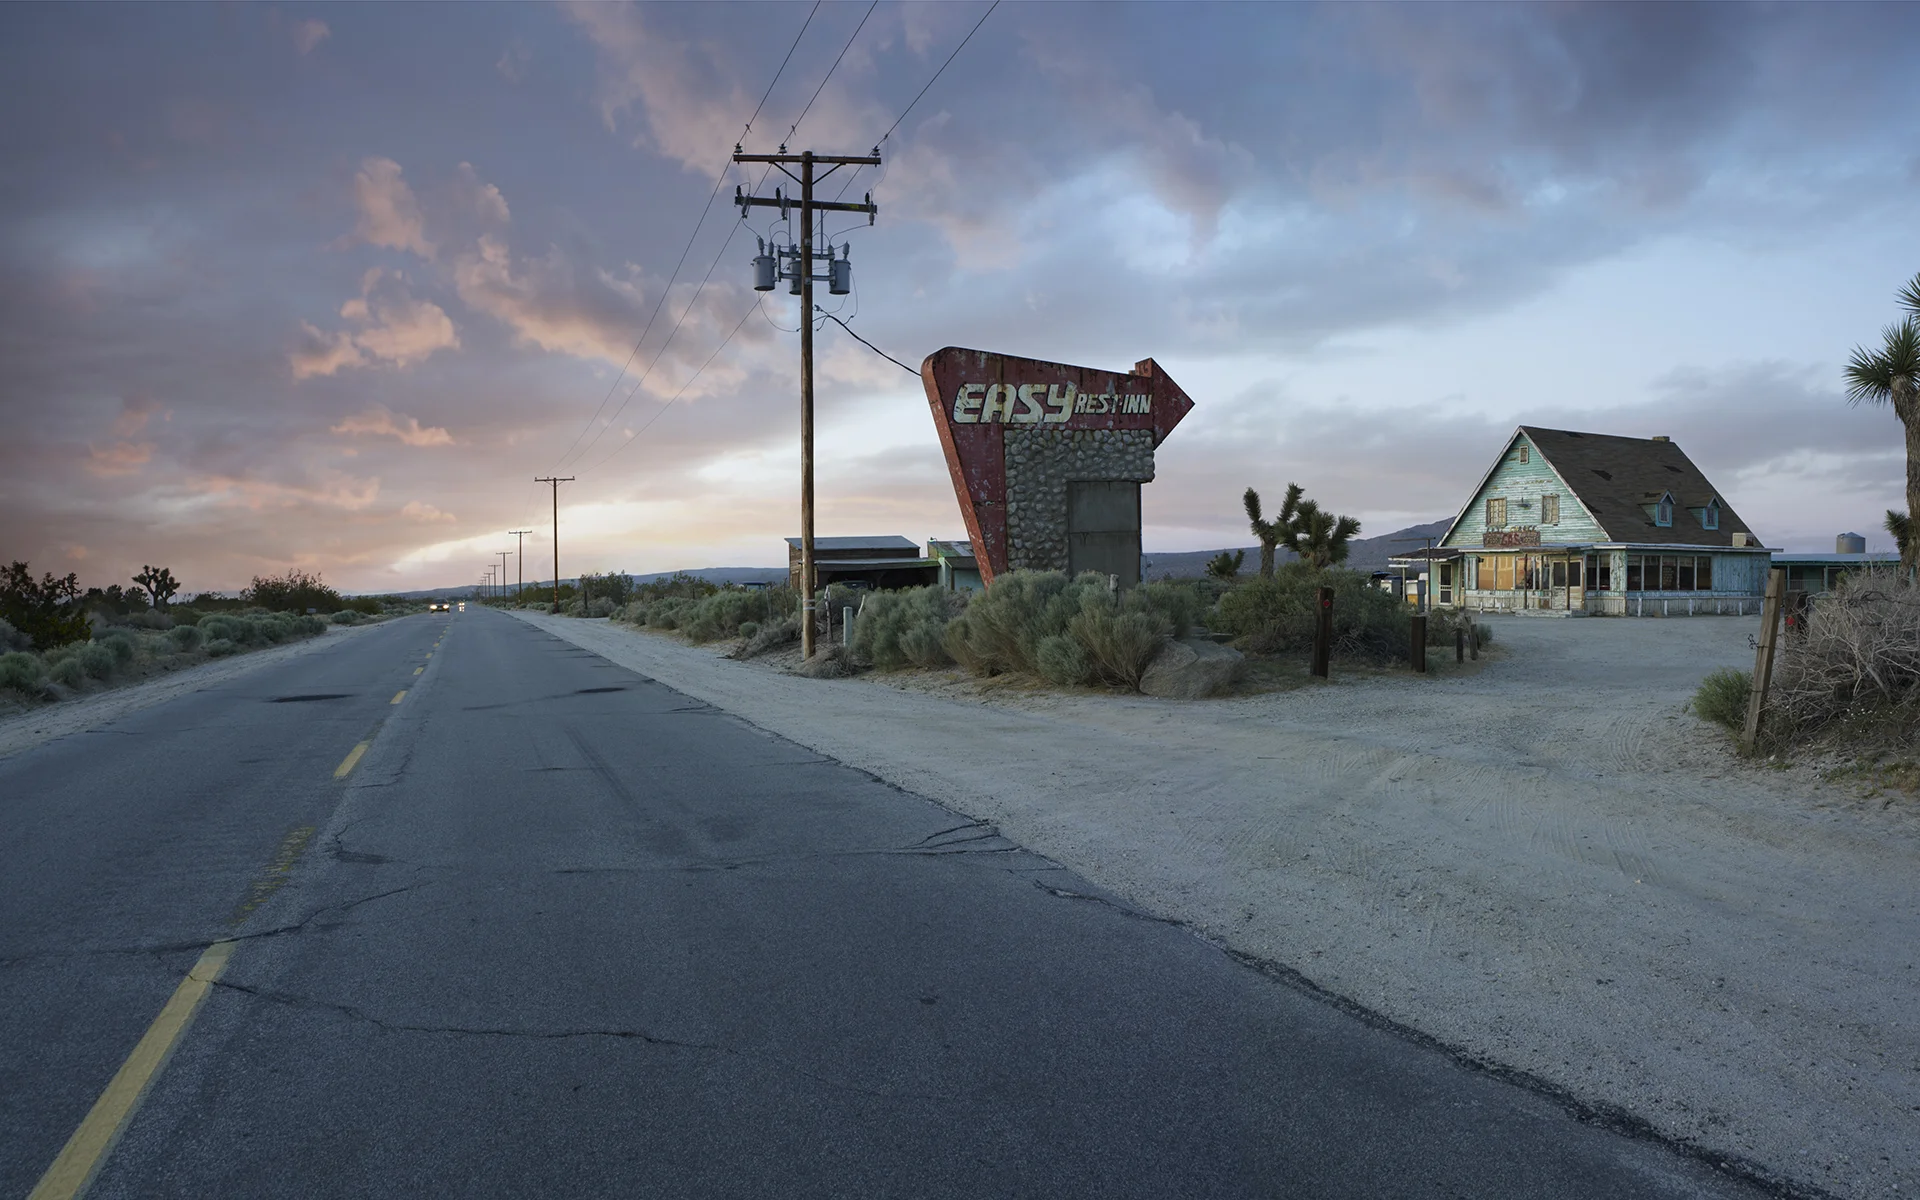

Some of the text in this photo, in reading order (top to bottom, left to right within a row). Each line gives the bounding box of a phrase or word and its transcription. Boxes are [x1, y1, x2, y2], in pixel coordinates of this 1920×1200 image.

[953, 382, 1152, 424] EASY REST INN
